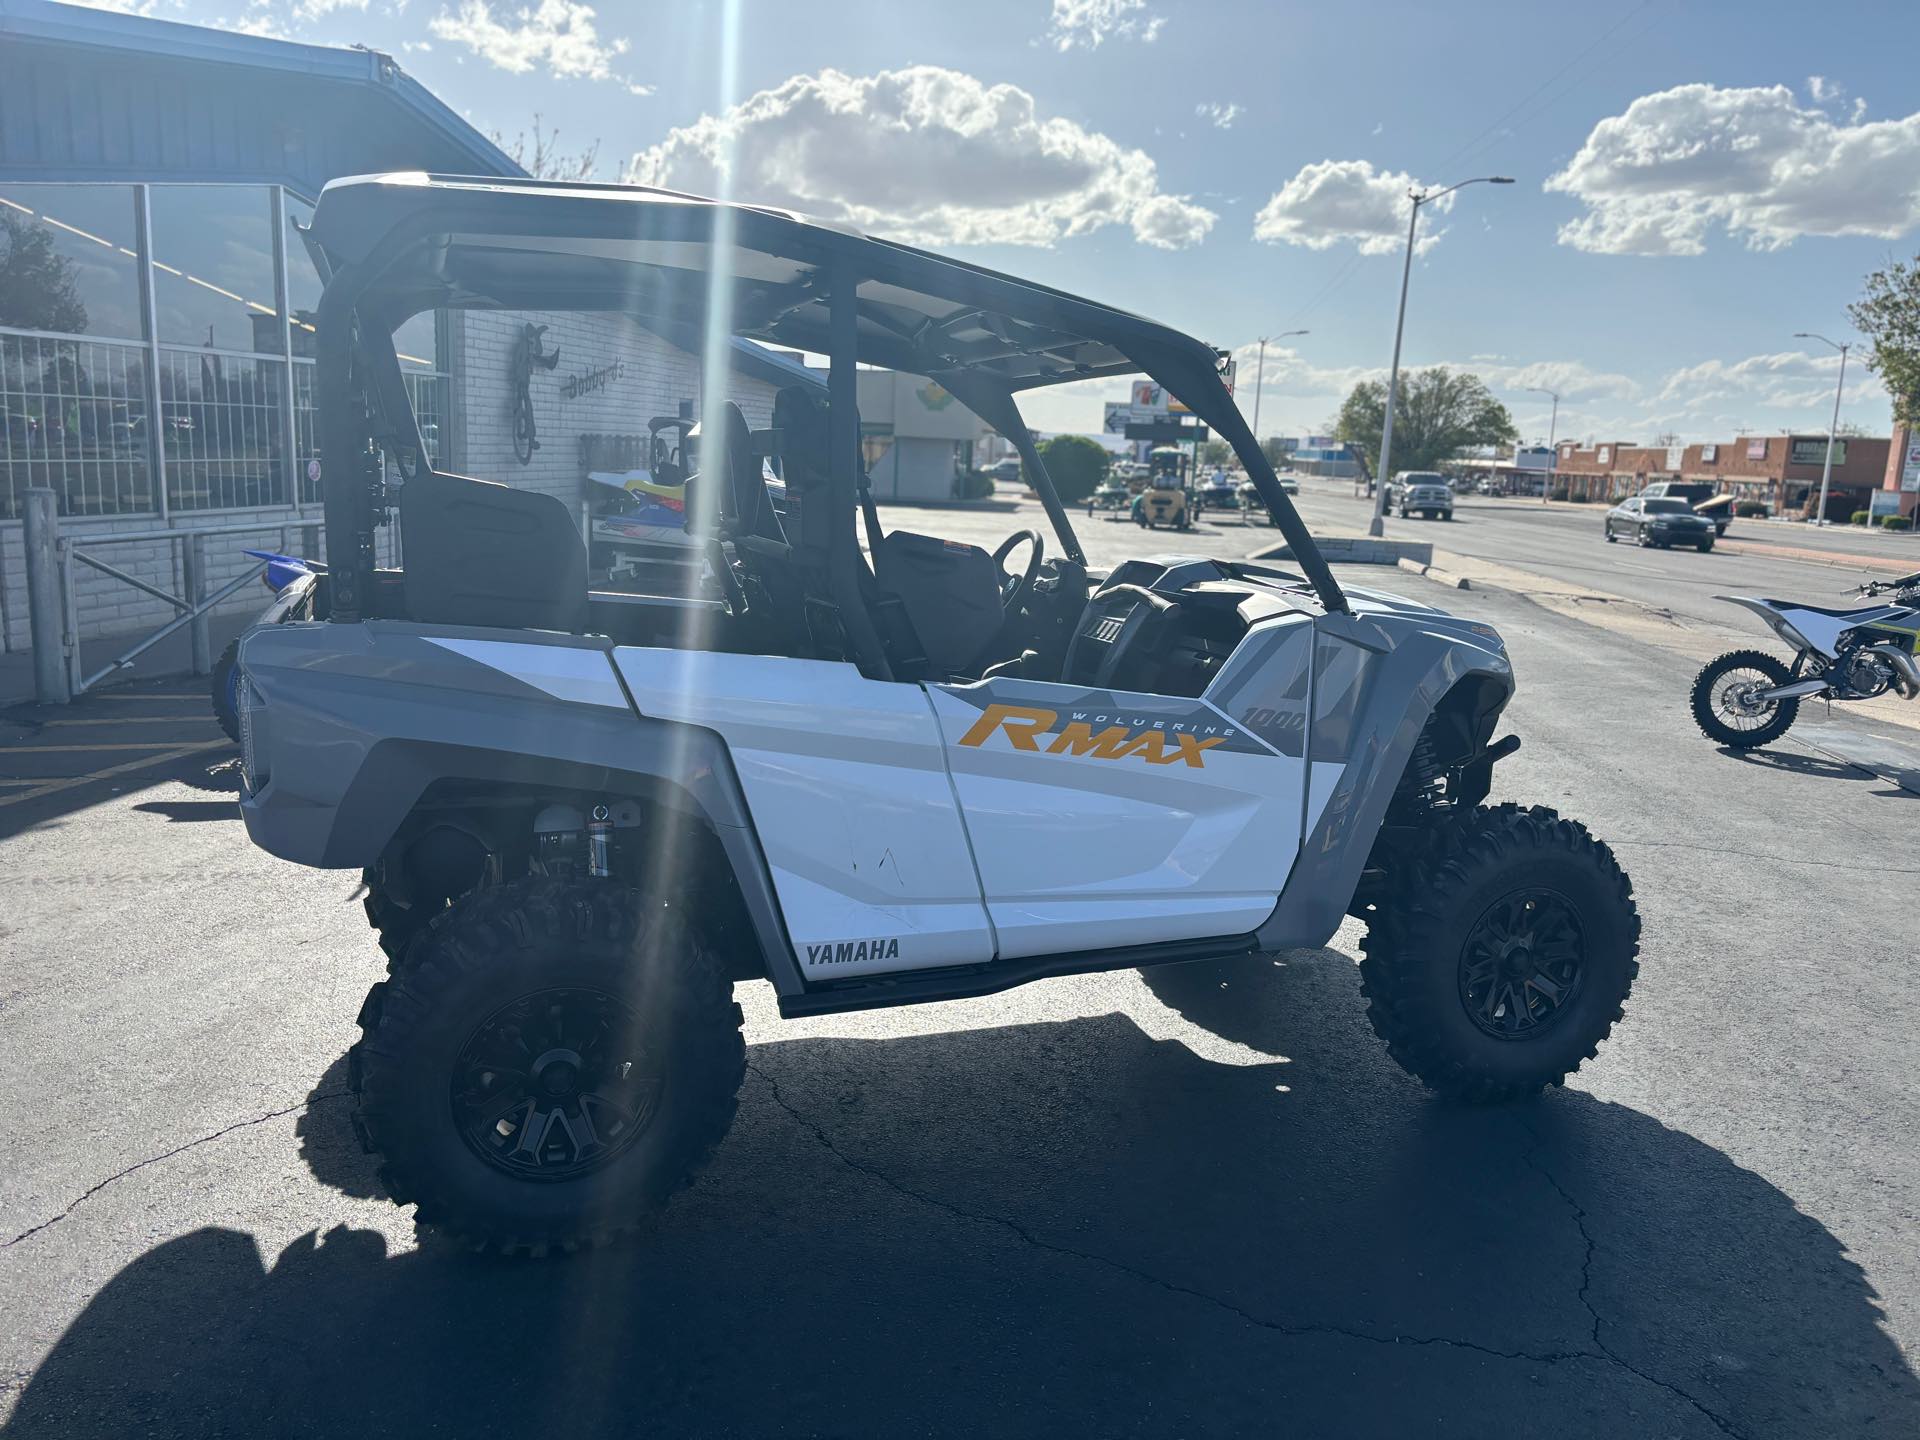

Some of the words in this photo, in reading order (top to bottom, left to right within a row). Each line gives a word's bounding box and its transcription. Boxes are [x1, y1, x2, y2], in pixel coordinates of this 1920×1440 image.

[563, 364, 606, 400] Bobby
[1071, 711, 1236, 737] WOLVERINE
[806, 938, 899, 965] YAMAHA
